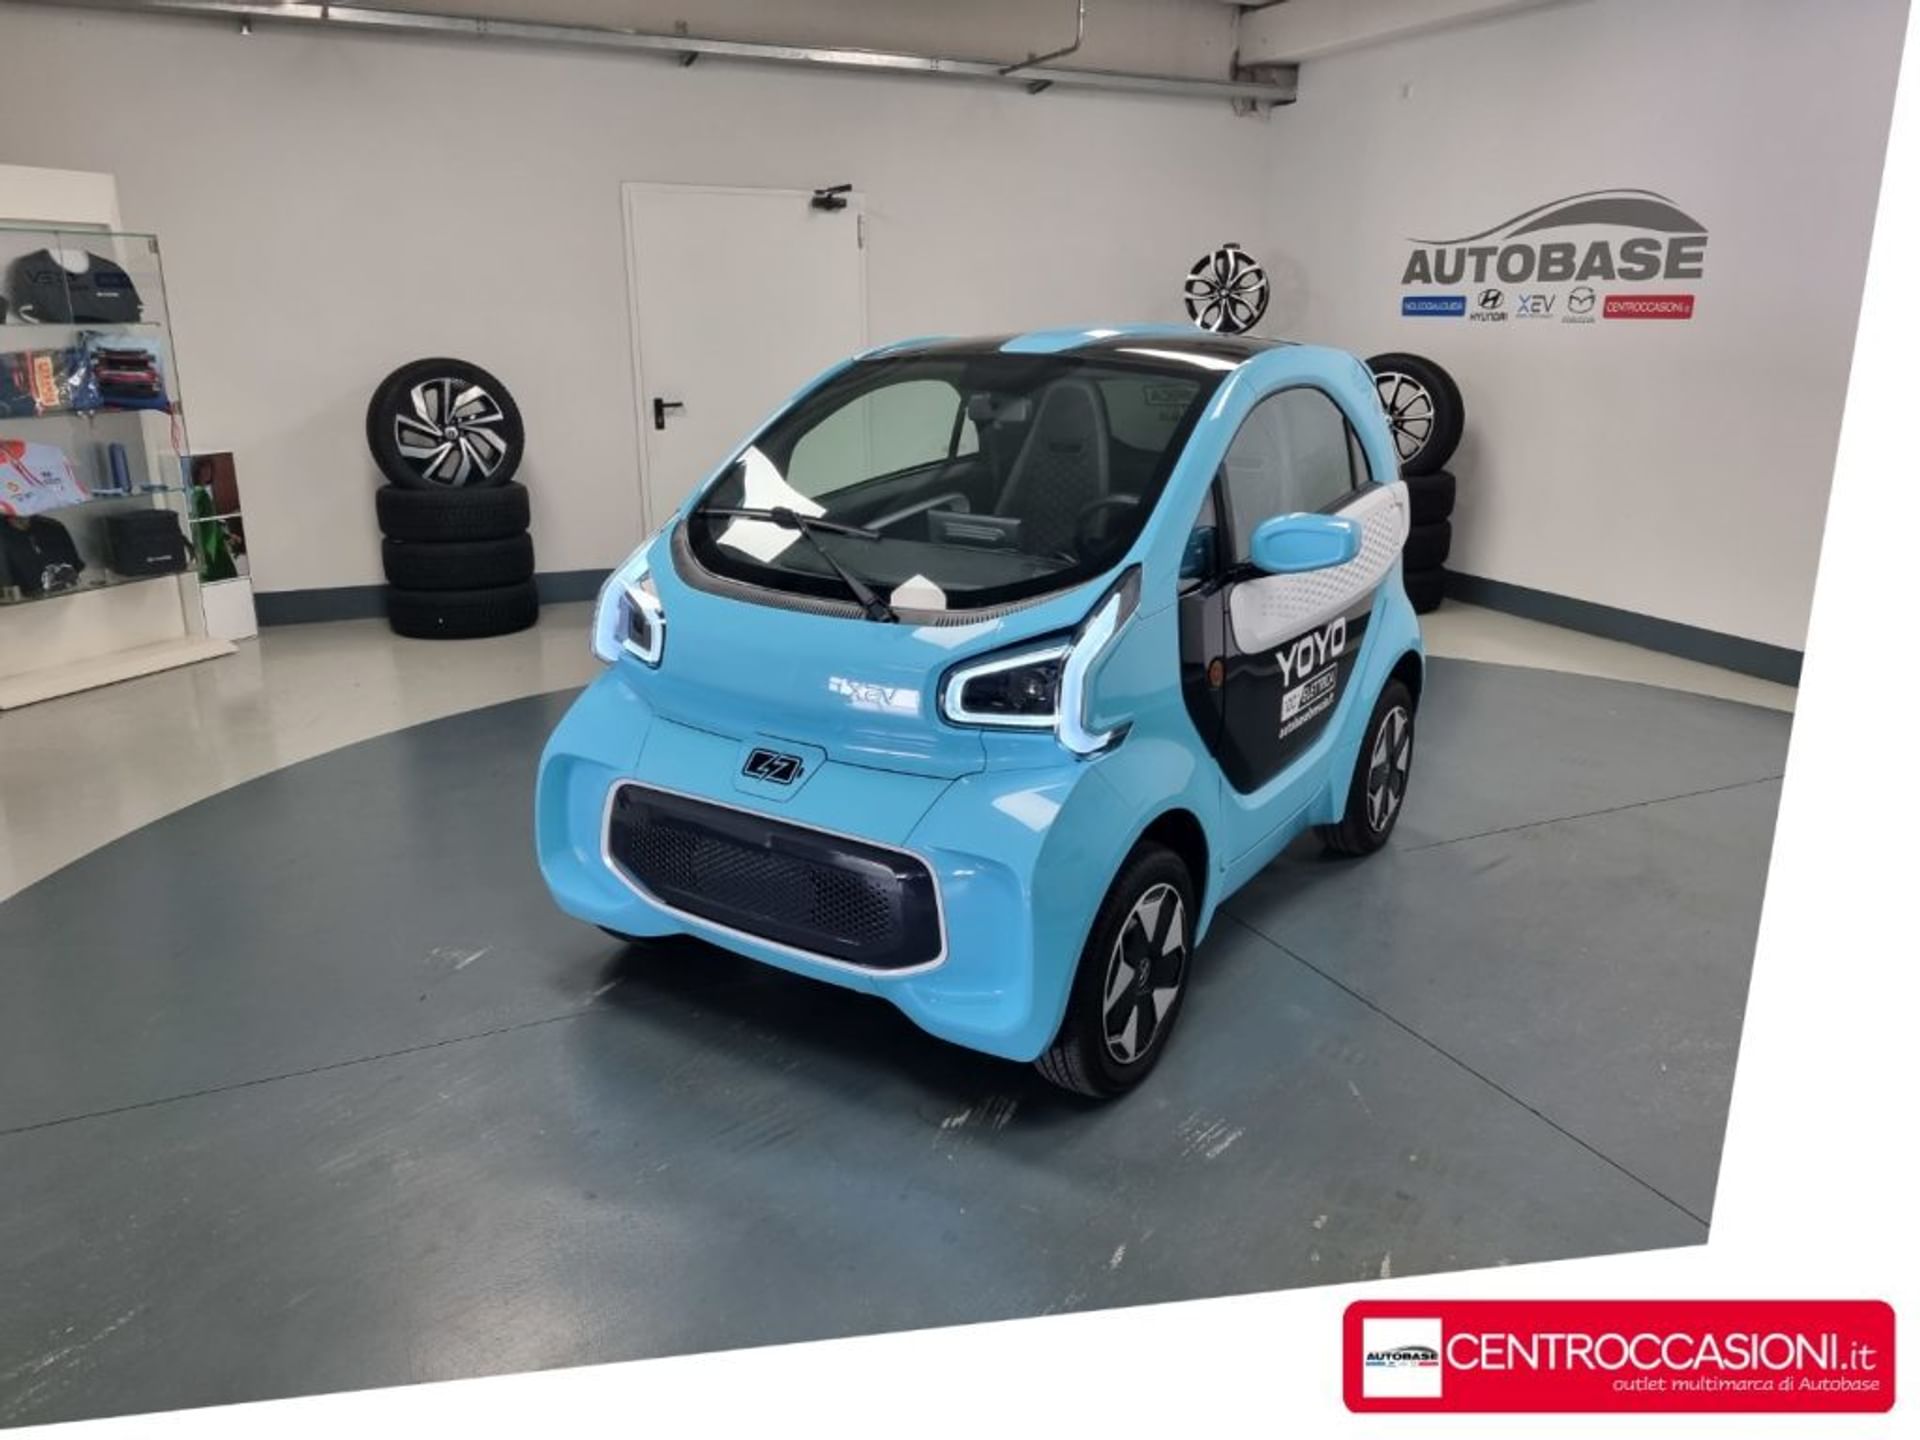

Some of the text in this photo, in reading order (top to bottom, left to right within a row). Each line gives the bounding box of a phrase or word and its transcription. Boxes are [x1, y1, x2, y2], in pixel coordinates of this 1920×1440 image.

[1401, 236, 1708, 285] AUTOBASE
[1517, 294, 1556, 313] XEV
[1275, 616, 1346, 687] YOYO
